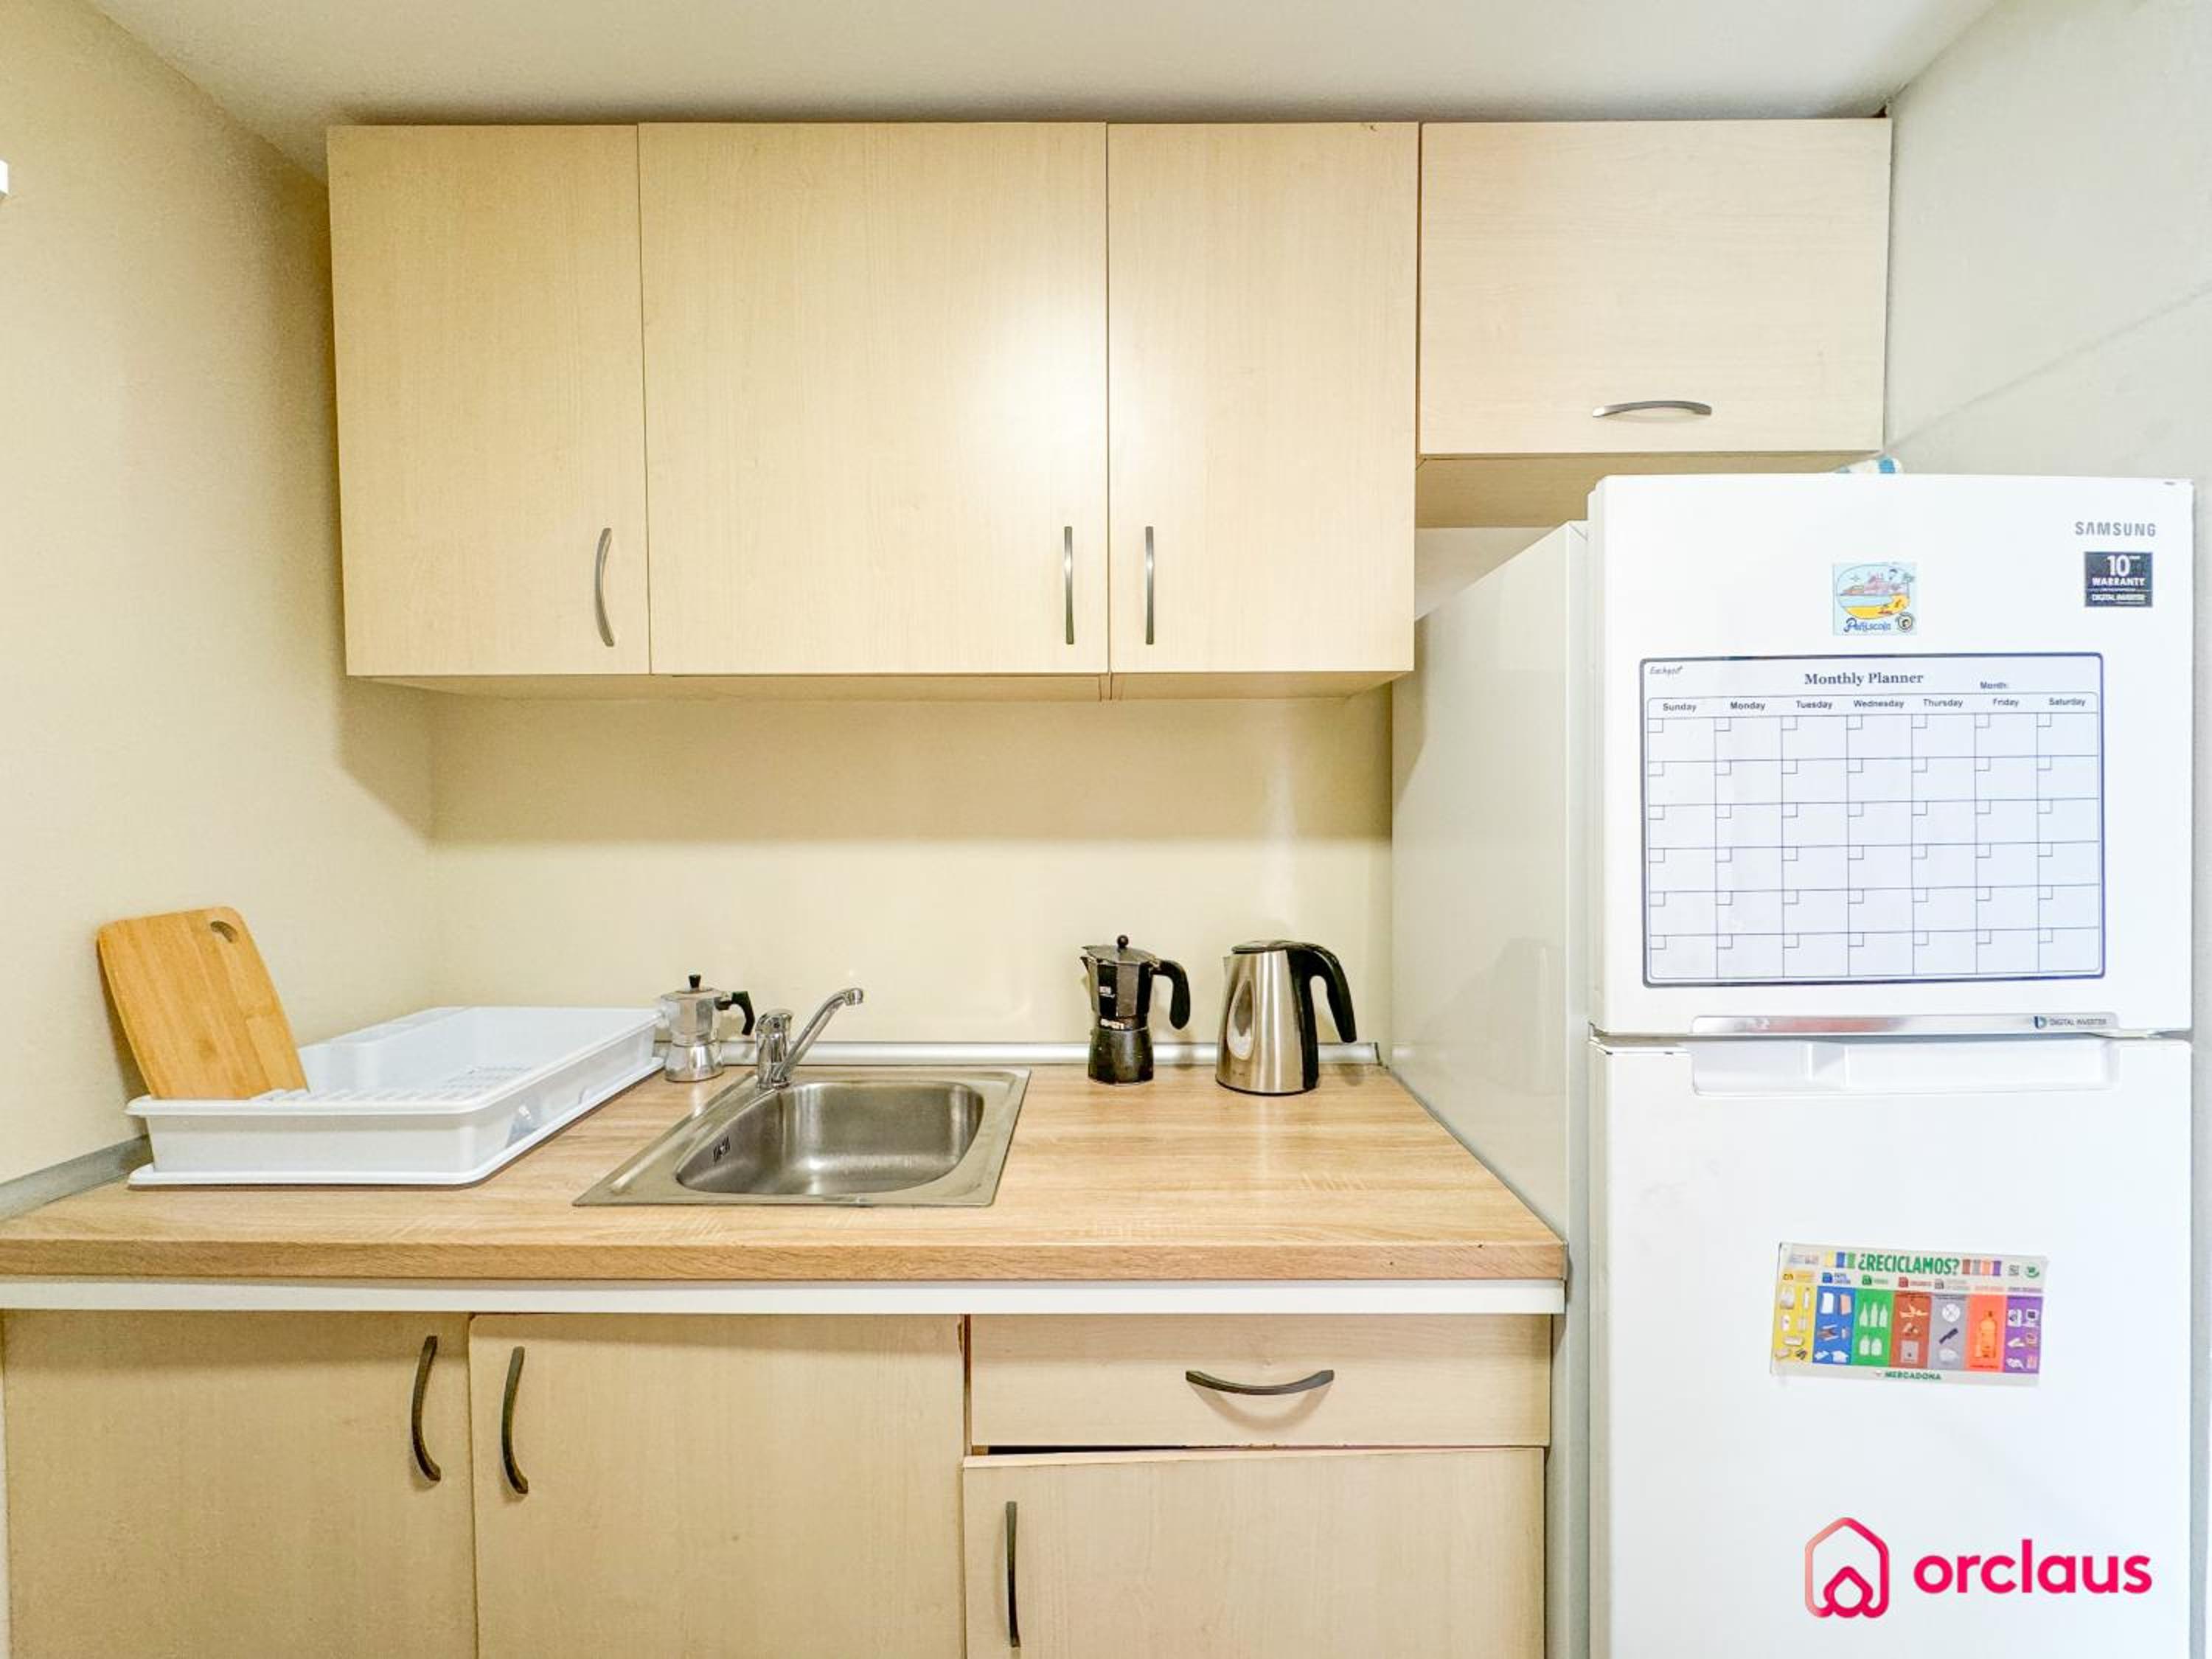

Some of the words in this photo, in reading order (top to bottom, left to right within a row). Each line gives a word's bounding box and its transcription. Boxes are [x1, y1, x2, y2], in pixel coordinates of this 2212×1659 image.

[2076, 521, 2157, 537] SAMSUNG
[2107, 554, 2130, 577] 10
[2092, 577, 2146, 586] WARRANTY
[1804, 672, 1863, 686] Monthly
[1868, 672, 1924, 684] Planner
[1663, 703, 1697, 712] Sunday
[1730, 701, 1766, 711] Monday
[1796, 700, 1833, 709] Tuesday
[1853, 699, 1905, 709] Wednesday
[1923, 698, 1964, 708] Thursday
[1993, 698, 2020, 706] Friday
[2048, 697, 2087, 706] Saturday
[1858, 1253, 1961, 1276] ¿RECICLAMOS?
[1885, 1371, 1942, 1381] MERCADONA
